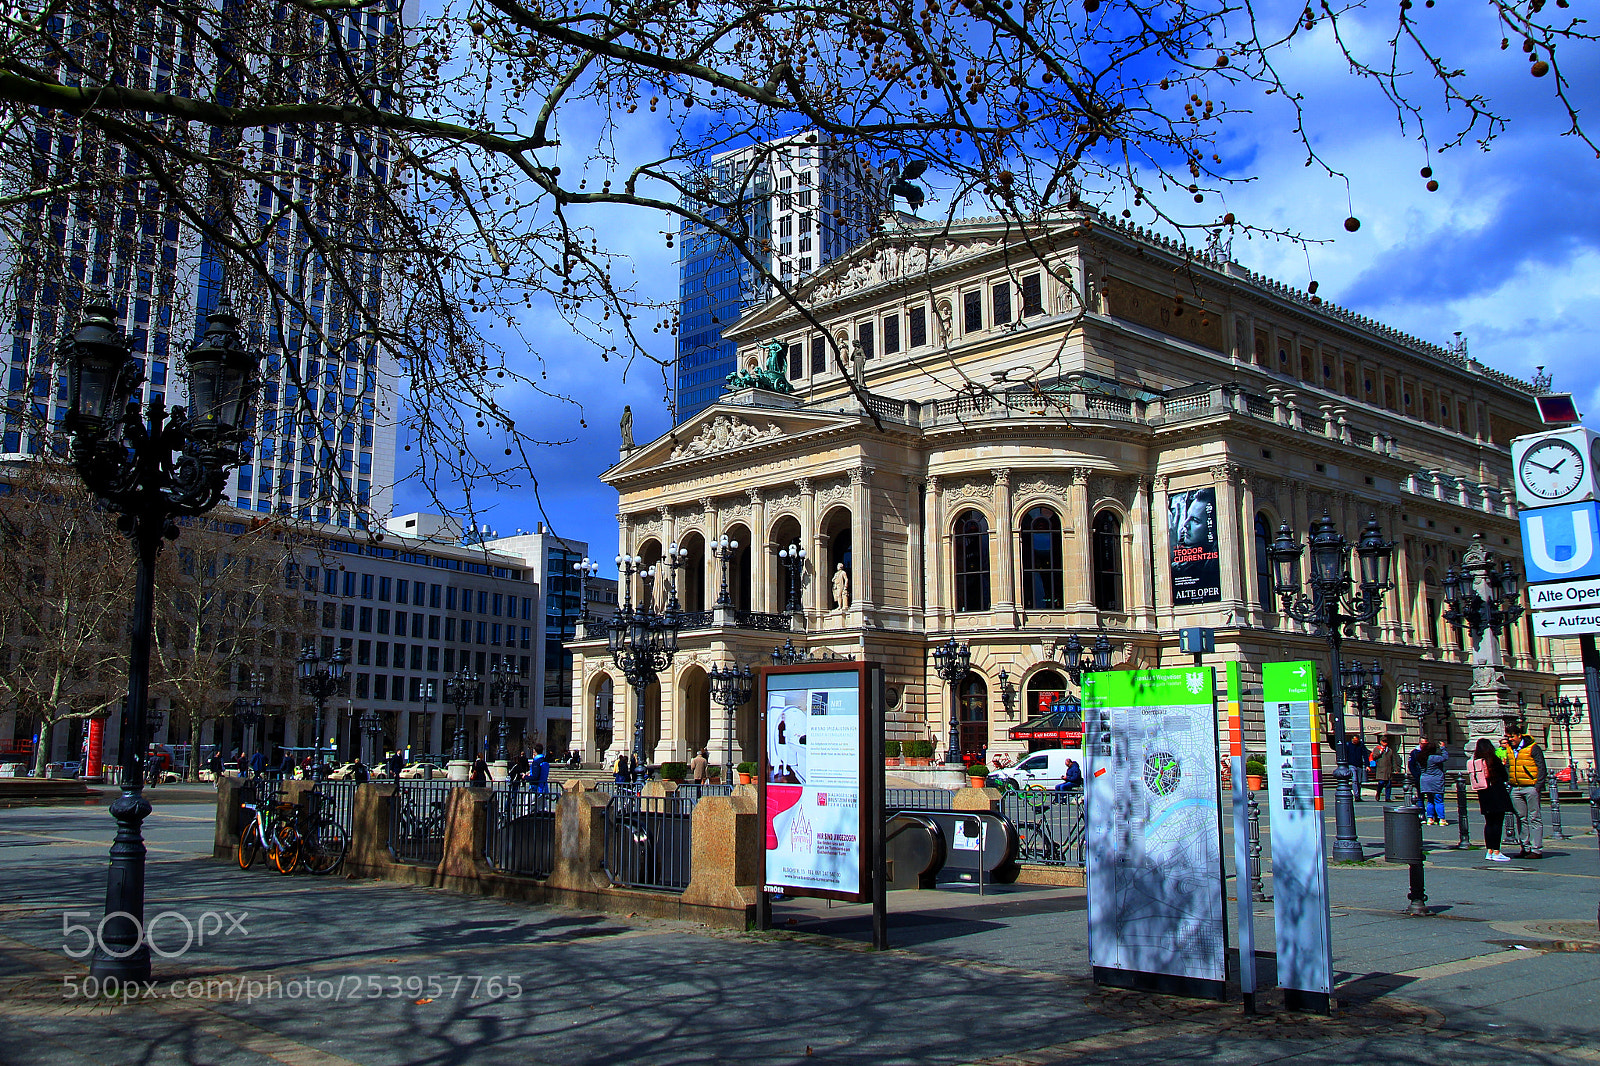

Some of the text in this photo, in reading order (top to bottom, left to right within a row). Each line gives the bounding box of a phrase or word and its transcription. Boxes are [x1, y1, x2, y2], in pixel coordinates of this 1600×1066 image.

[1526, 509, 1593, 574] U
[1173, 546, 1203, 556] TEODOR
[1173, 551, 1219, 563] CURRENTZIS
[1176, 587, 1219, 599] ALTE OPER
[1537, 587, 1600, 602] Alte Oper
[1558, 615, 1600, 627] Aufzug
